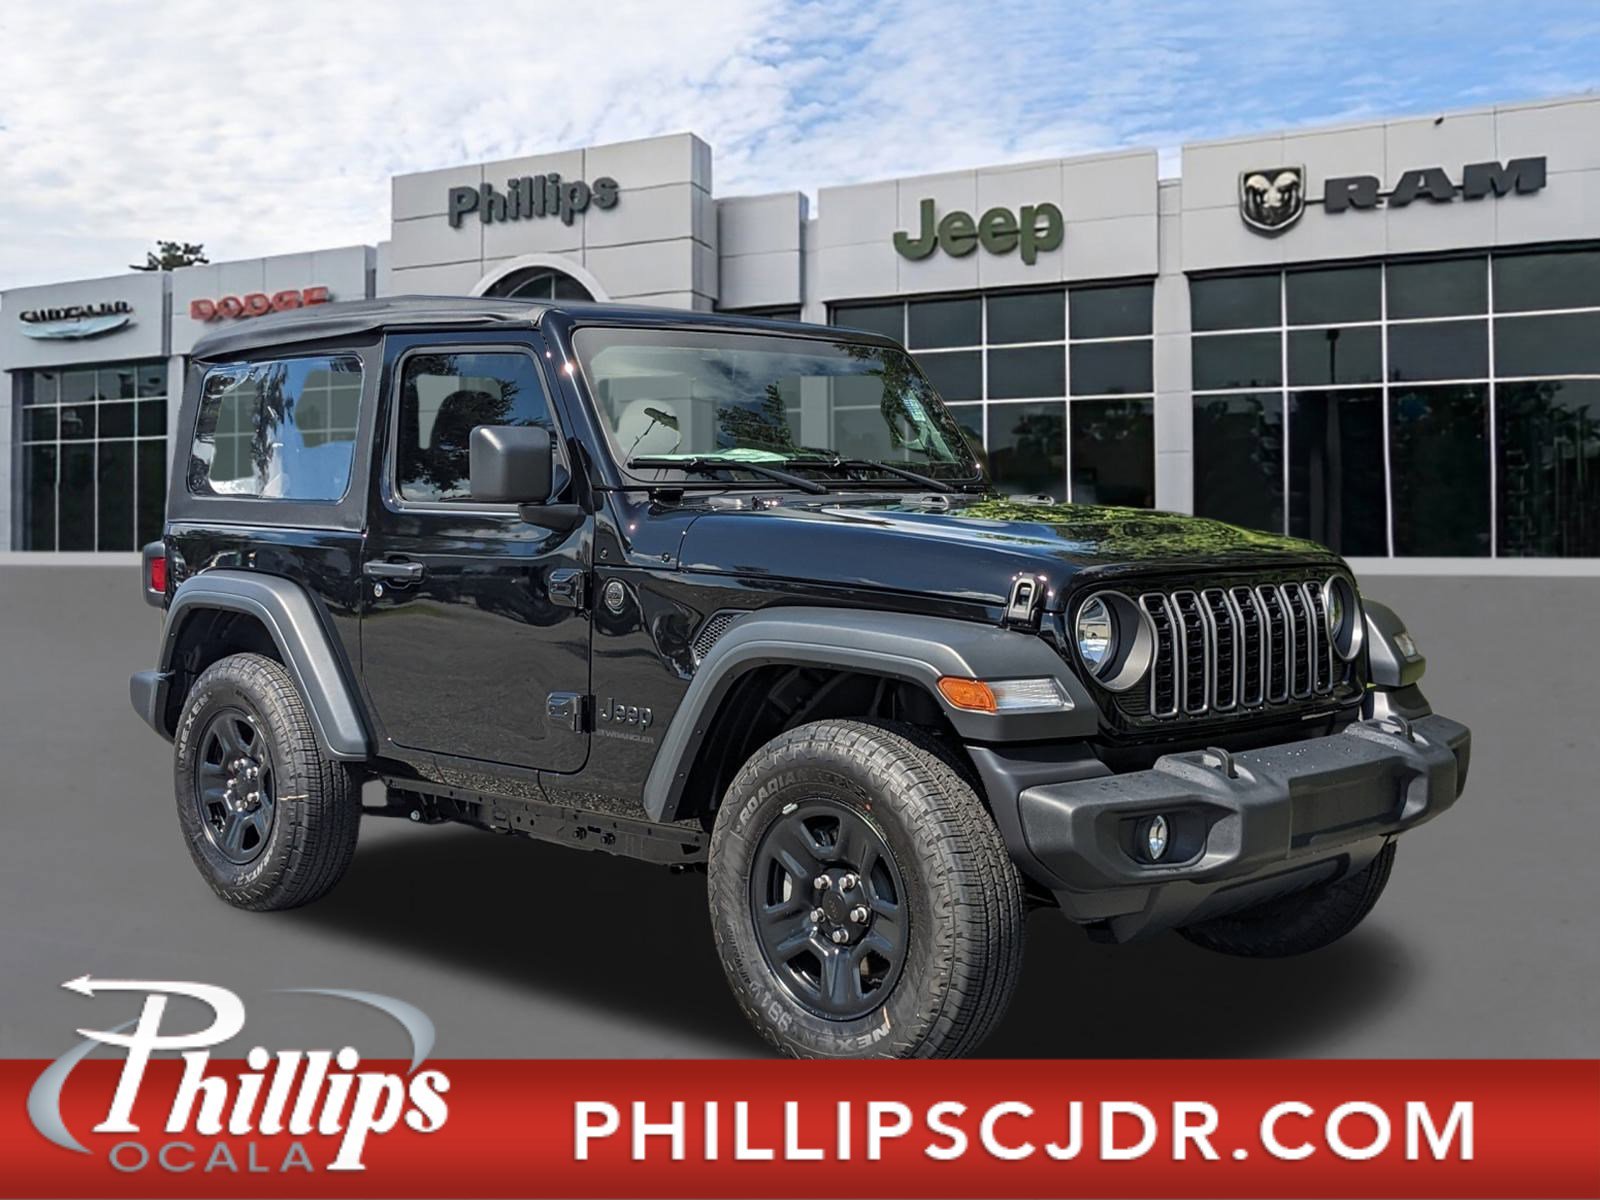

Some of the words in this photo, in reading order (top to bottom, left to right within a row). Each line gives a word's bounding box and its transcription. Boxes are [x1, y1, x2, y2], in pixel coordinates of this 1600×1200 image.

[448, 173, 620, 228] Phillips
[1325, 157, 1547, 213] RAM
[893, 198, 1065, 266] Jeep
[191, 286, 329, 321] DODGE
[600, 697, 653, 731] Jeep
